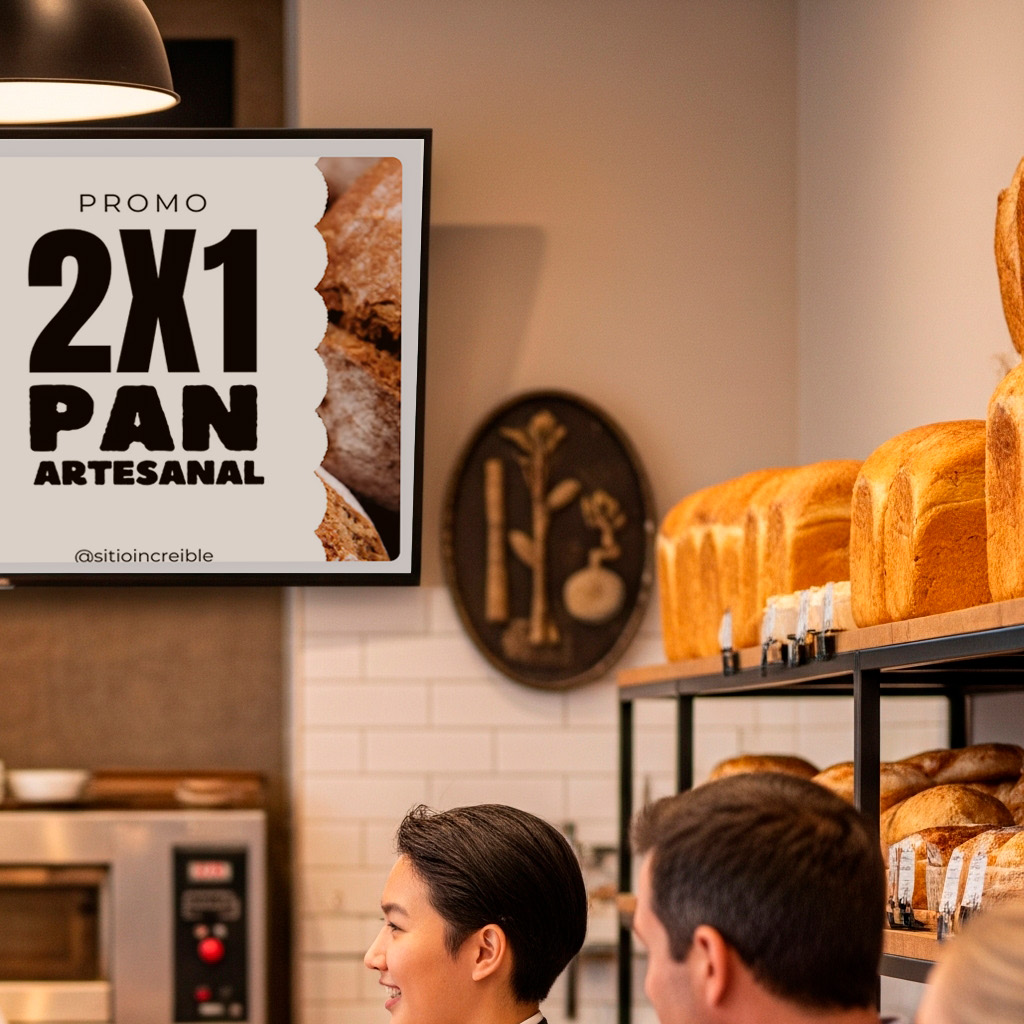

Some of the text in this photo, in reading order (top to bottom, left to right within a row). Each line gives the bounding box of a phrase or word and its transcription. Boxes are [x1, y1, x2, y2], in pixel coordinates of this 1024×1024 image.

[78, 193, 208, 213] PROMO
[27, 228, 259, 374] 2X1
[28, 384, 258, 452] PAN
[33, 460, 265, 486] ARTESANAL
[74, 548, 214, 563] @sitioincreible
